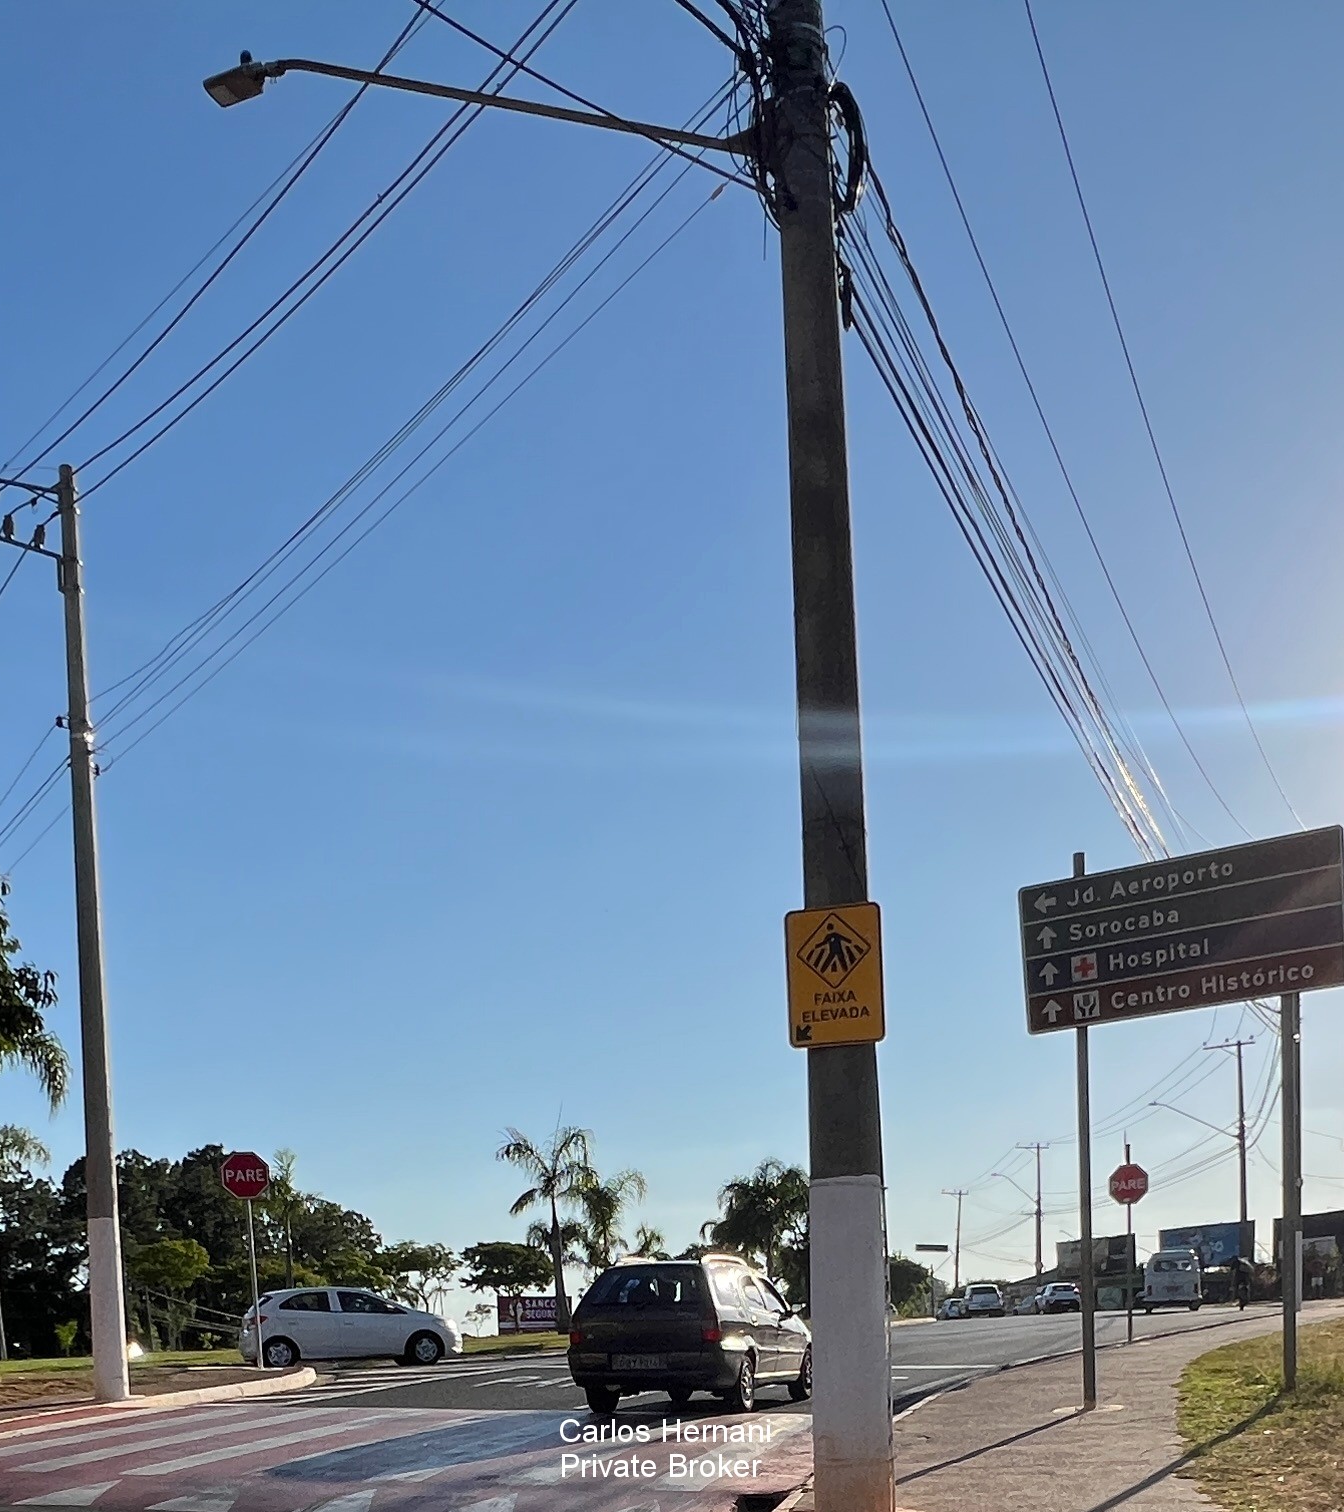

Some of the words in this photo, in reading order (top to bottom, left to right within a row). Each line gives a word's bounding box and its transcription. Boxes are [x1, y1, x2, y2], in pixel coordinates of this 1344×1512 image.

[1066, 887, 1102, 908] Jd.
[1109, 861, 1234, 900] Aeroporto
[1069, 906, 1180, 942] Sorocaba
[1109, 938, 1210, 972] Hospital
[813, 990, 858, 1006] FAIXA
[1111, 982, 1191, 1010] Centro
[1201, 963, 1315, 995] Histórico
[802, 1006, 870, 1023] ELEVADA
[225, 1169, 266, 1183] PARE
[1110, 1178, 1146, 1192] PARE
